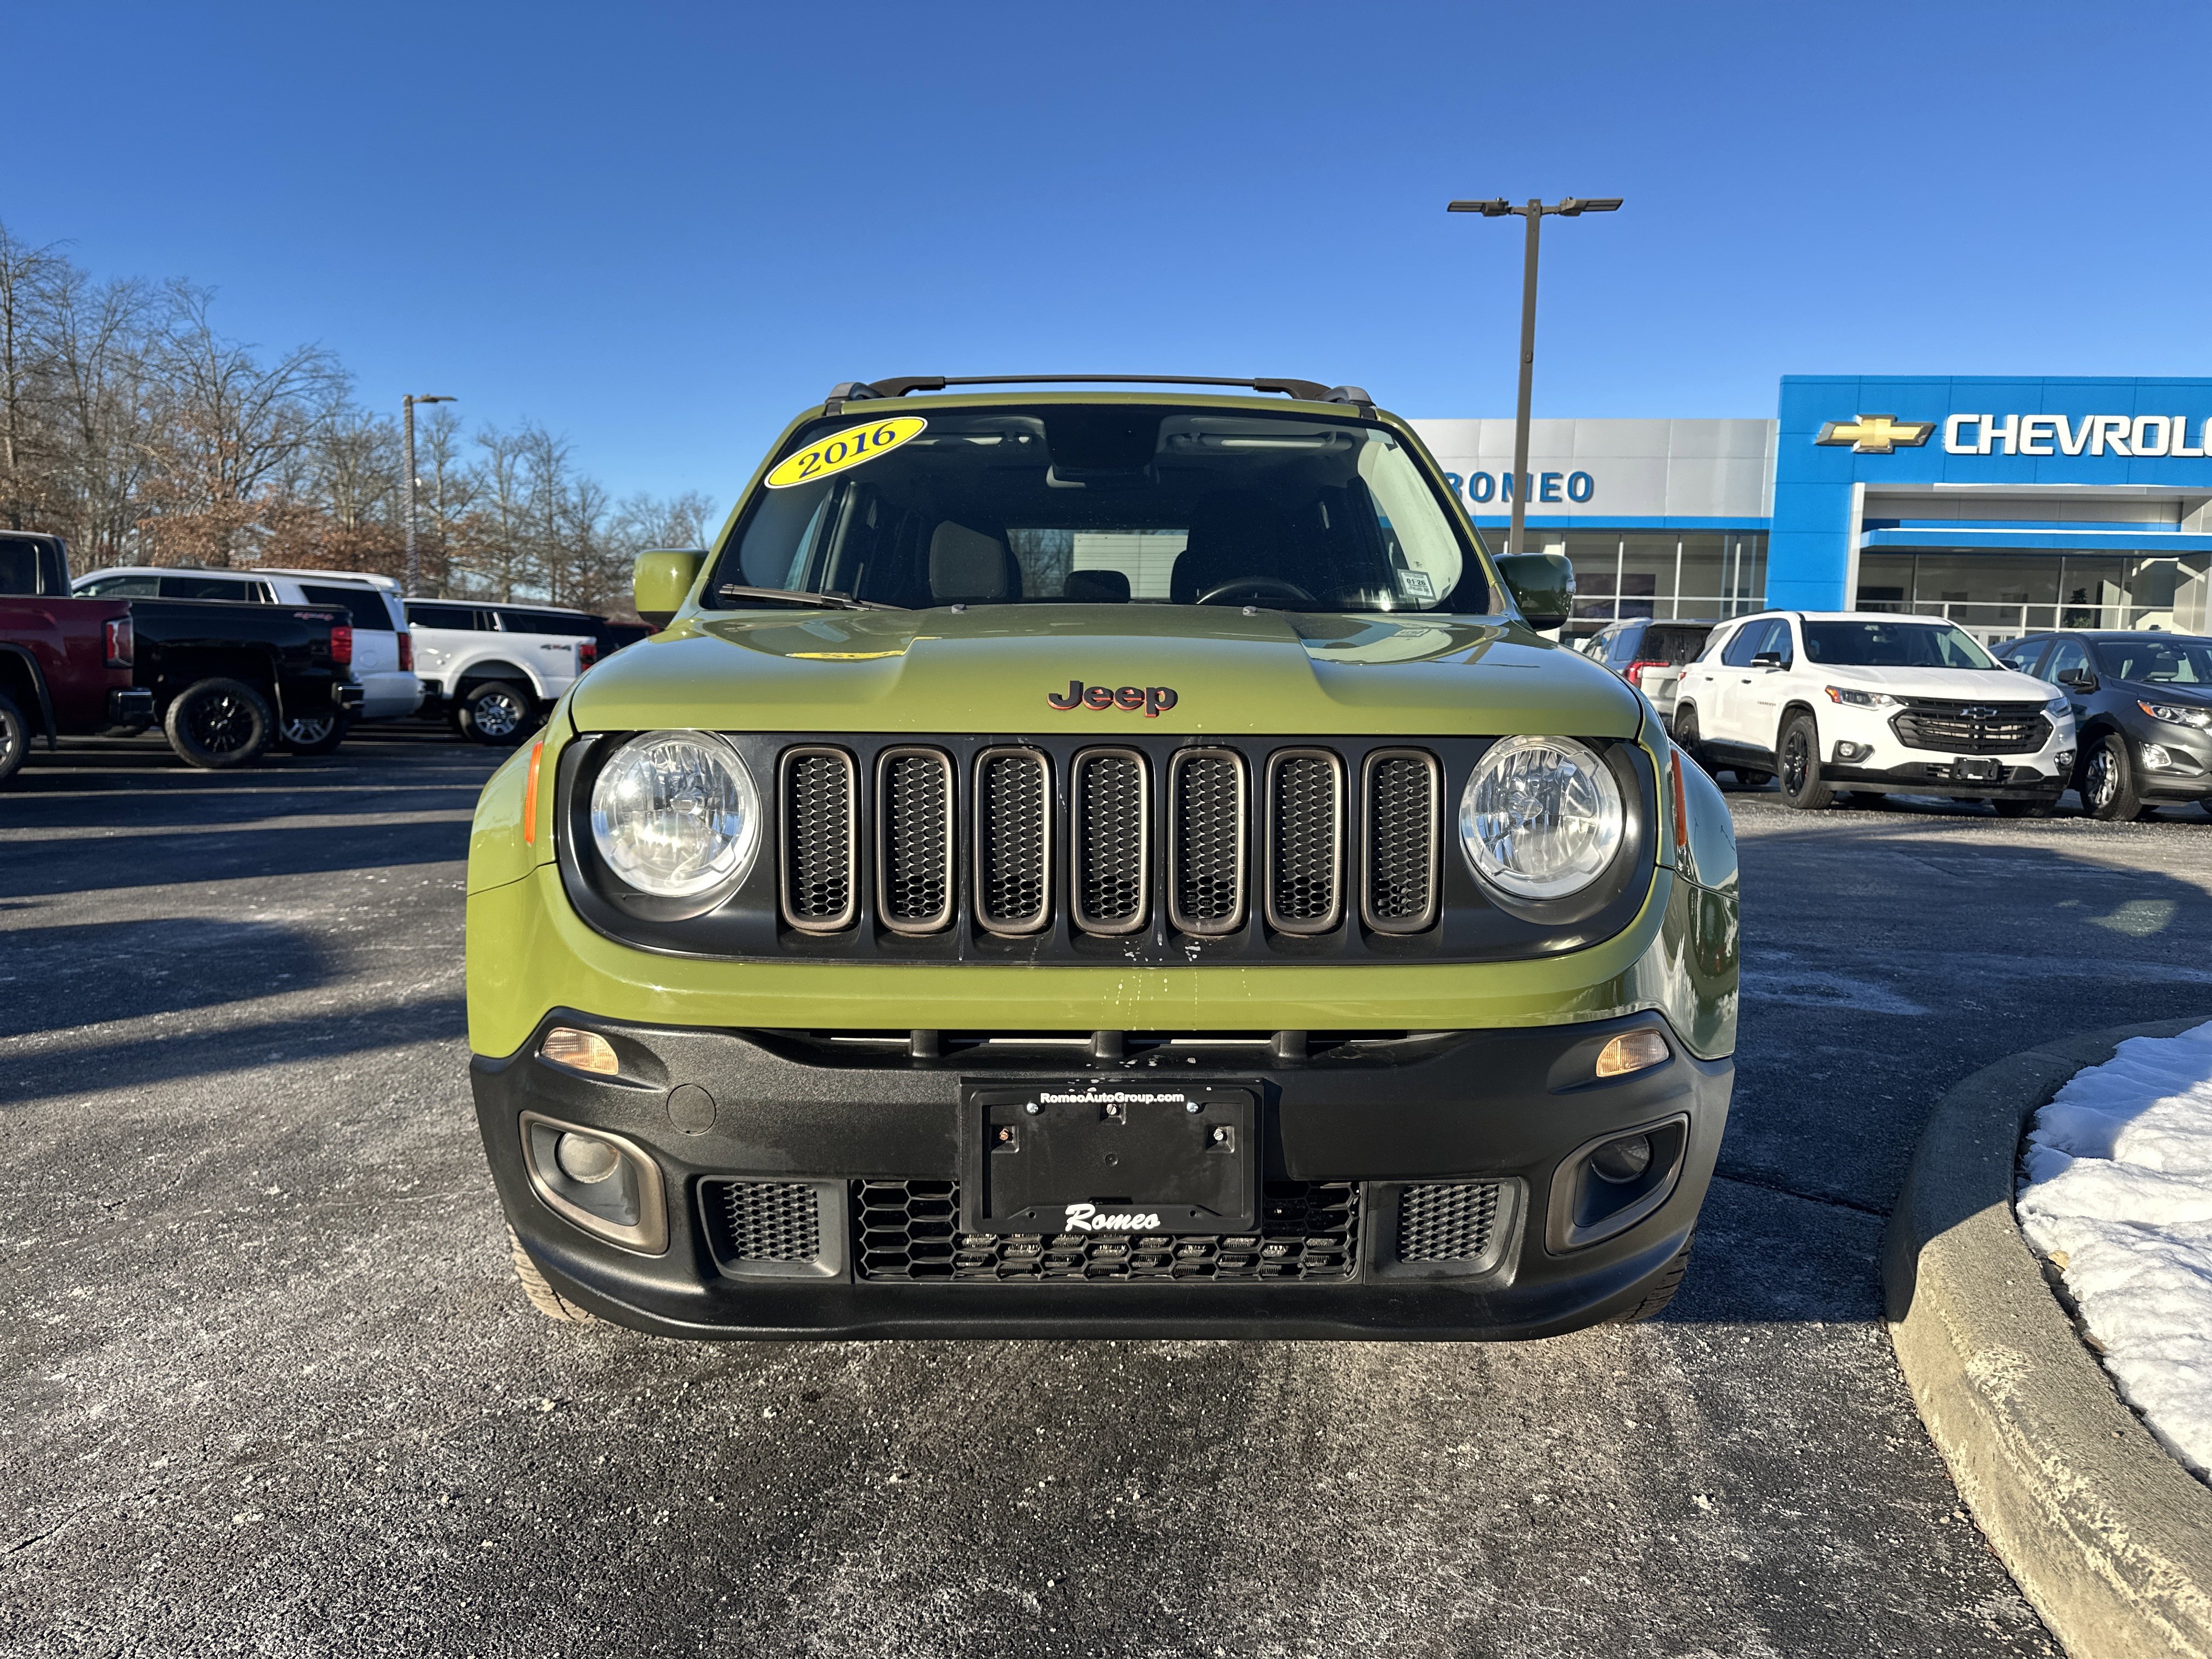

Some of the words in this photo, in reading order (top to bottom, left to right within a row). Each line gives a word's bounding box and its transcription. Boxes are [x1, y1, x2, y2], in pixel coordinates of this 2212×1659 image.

[798, 421, 896, 479] 2016
[1944, 414, 2212, 458] CHEVROL
[1047, 680, 1178, 718] Jeep
[1040, 1092, 1185, 1104] RomeoAutoGroup.com
[1065, 1203, 1161, 1232] Romeo
